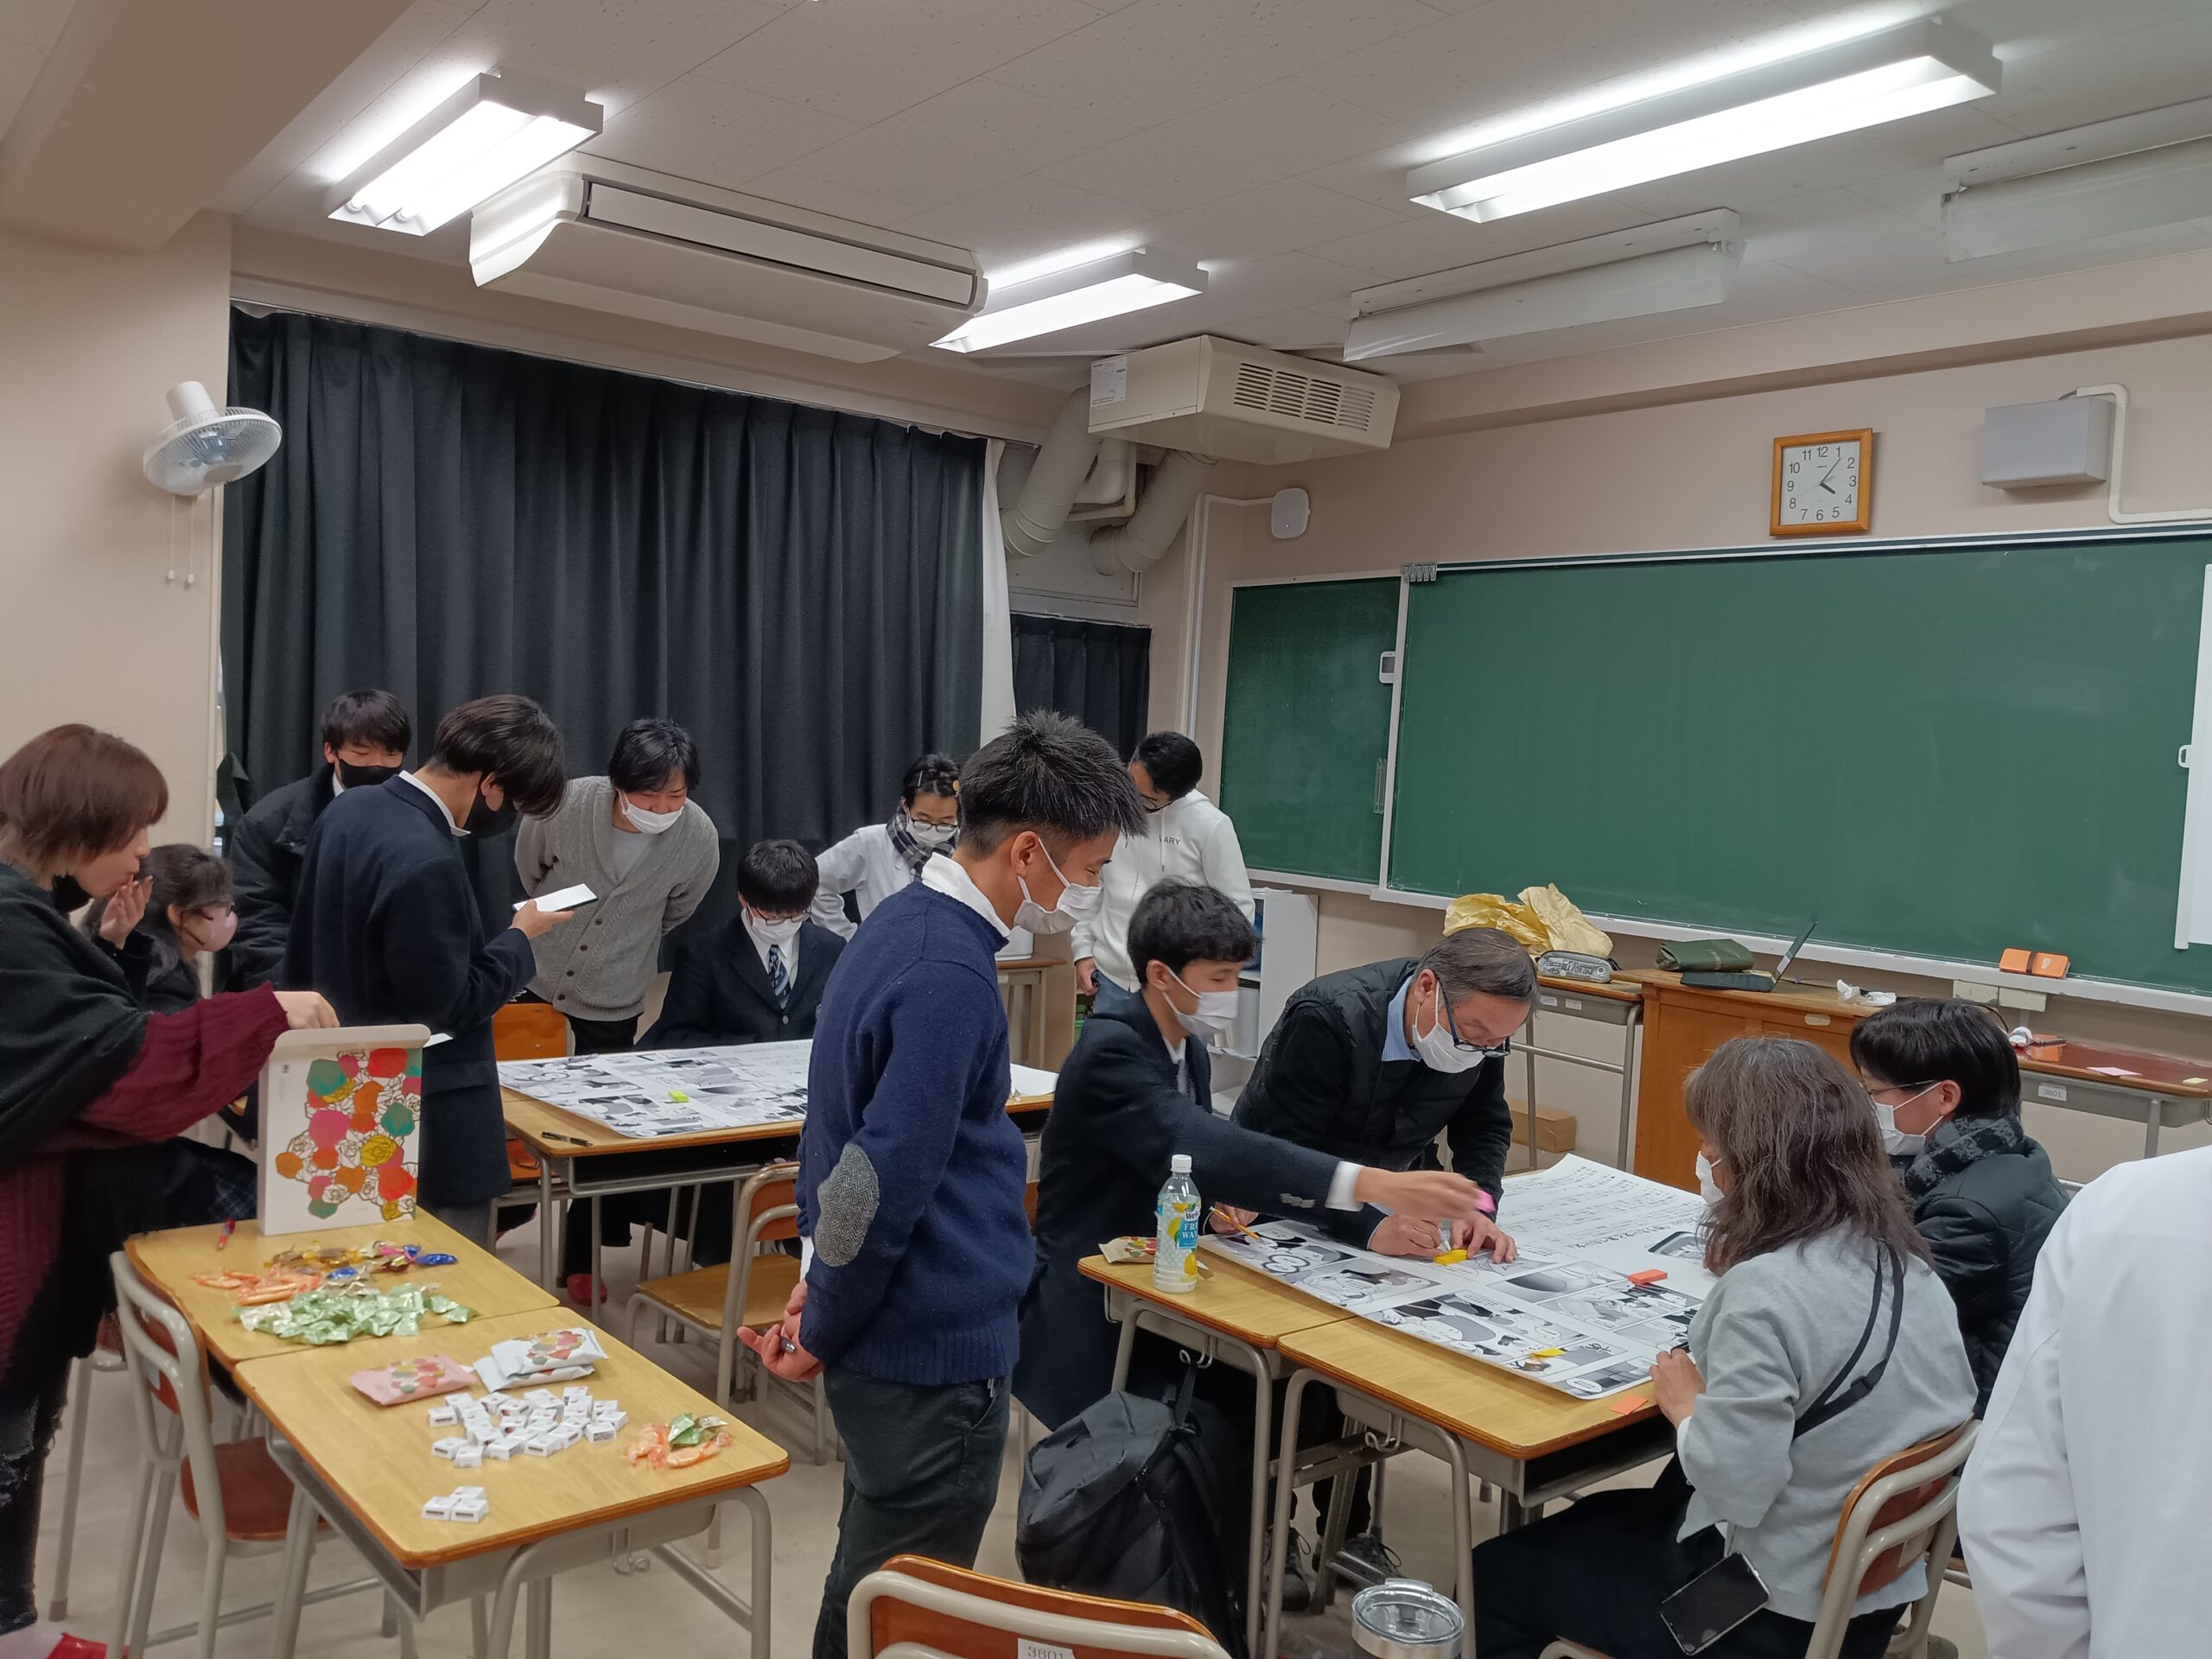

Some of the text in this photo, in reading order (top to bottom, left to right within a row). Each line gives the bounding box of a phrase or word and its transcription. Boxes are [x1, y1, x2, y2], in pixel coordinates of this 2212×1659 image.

[1802, 449, 1812, 461] 11
[1816, 446, 1828, 458] 12
[1835, 446, 1841, 458] 1
[1789, 461, 1801, 474] 10
[1847, 457, 1855, 469] 2
[1787, 480, 1795, 493] 9
[1848, 475, 1857, 487] 3
[1789, 497, 1796, 509] 8
[1845, 493, 1853, 505] 4
[1800, 508, 1808, 520] 7
[1815, 509, 1824, 521] 6
[1832, 506, 1840, 518] 5
